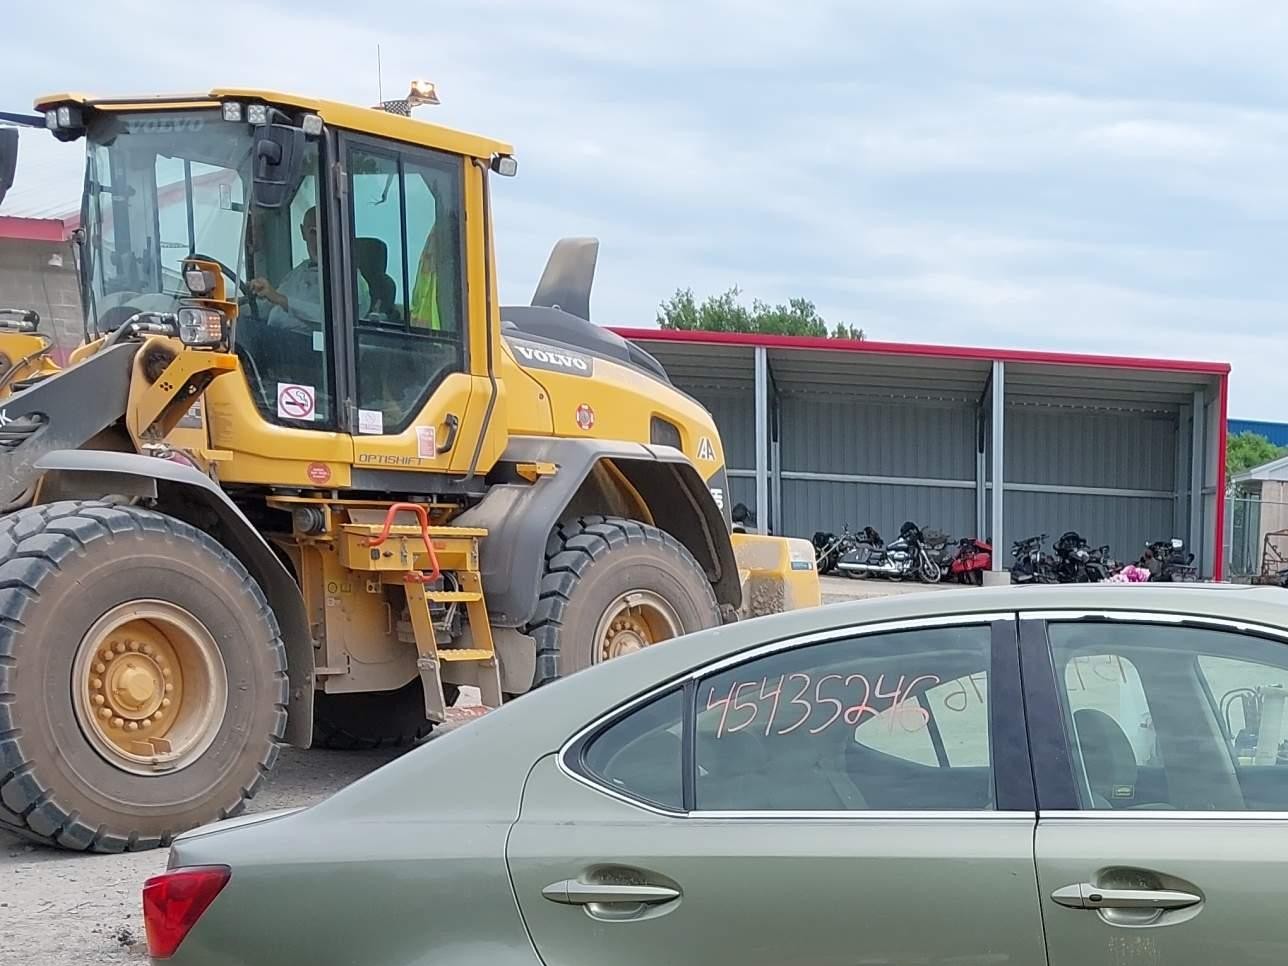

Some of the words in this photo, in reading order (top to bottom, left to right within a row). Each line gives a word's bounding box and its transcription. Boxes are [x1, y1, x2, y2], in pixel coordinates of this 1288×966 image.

[514, 346, 587, 370] VOLVO
[359, 454, 424, 466] OPTISHIFT
[706, 673, 941, 739] 45435246
